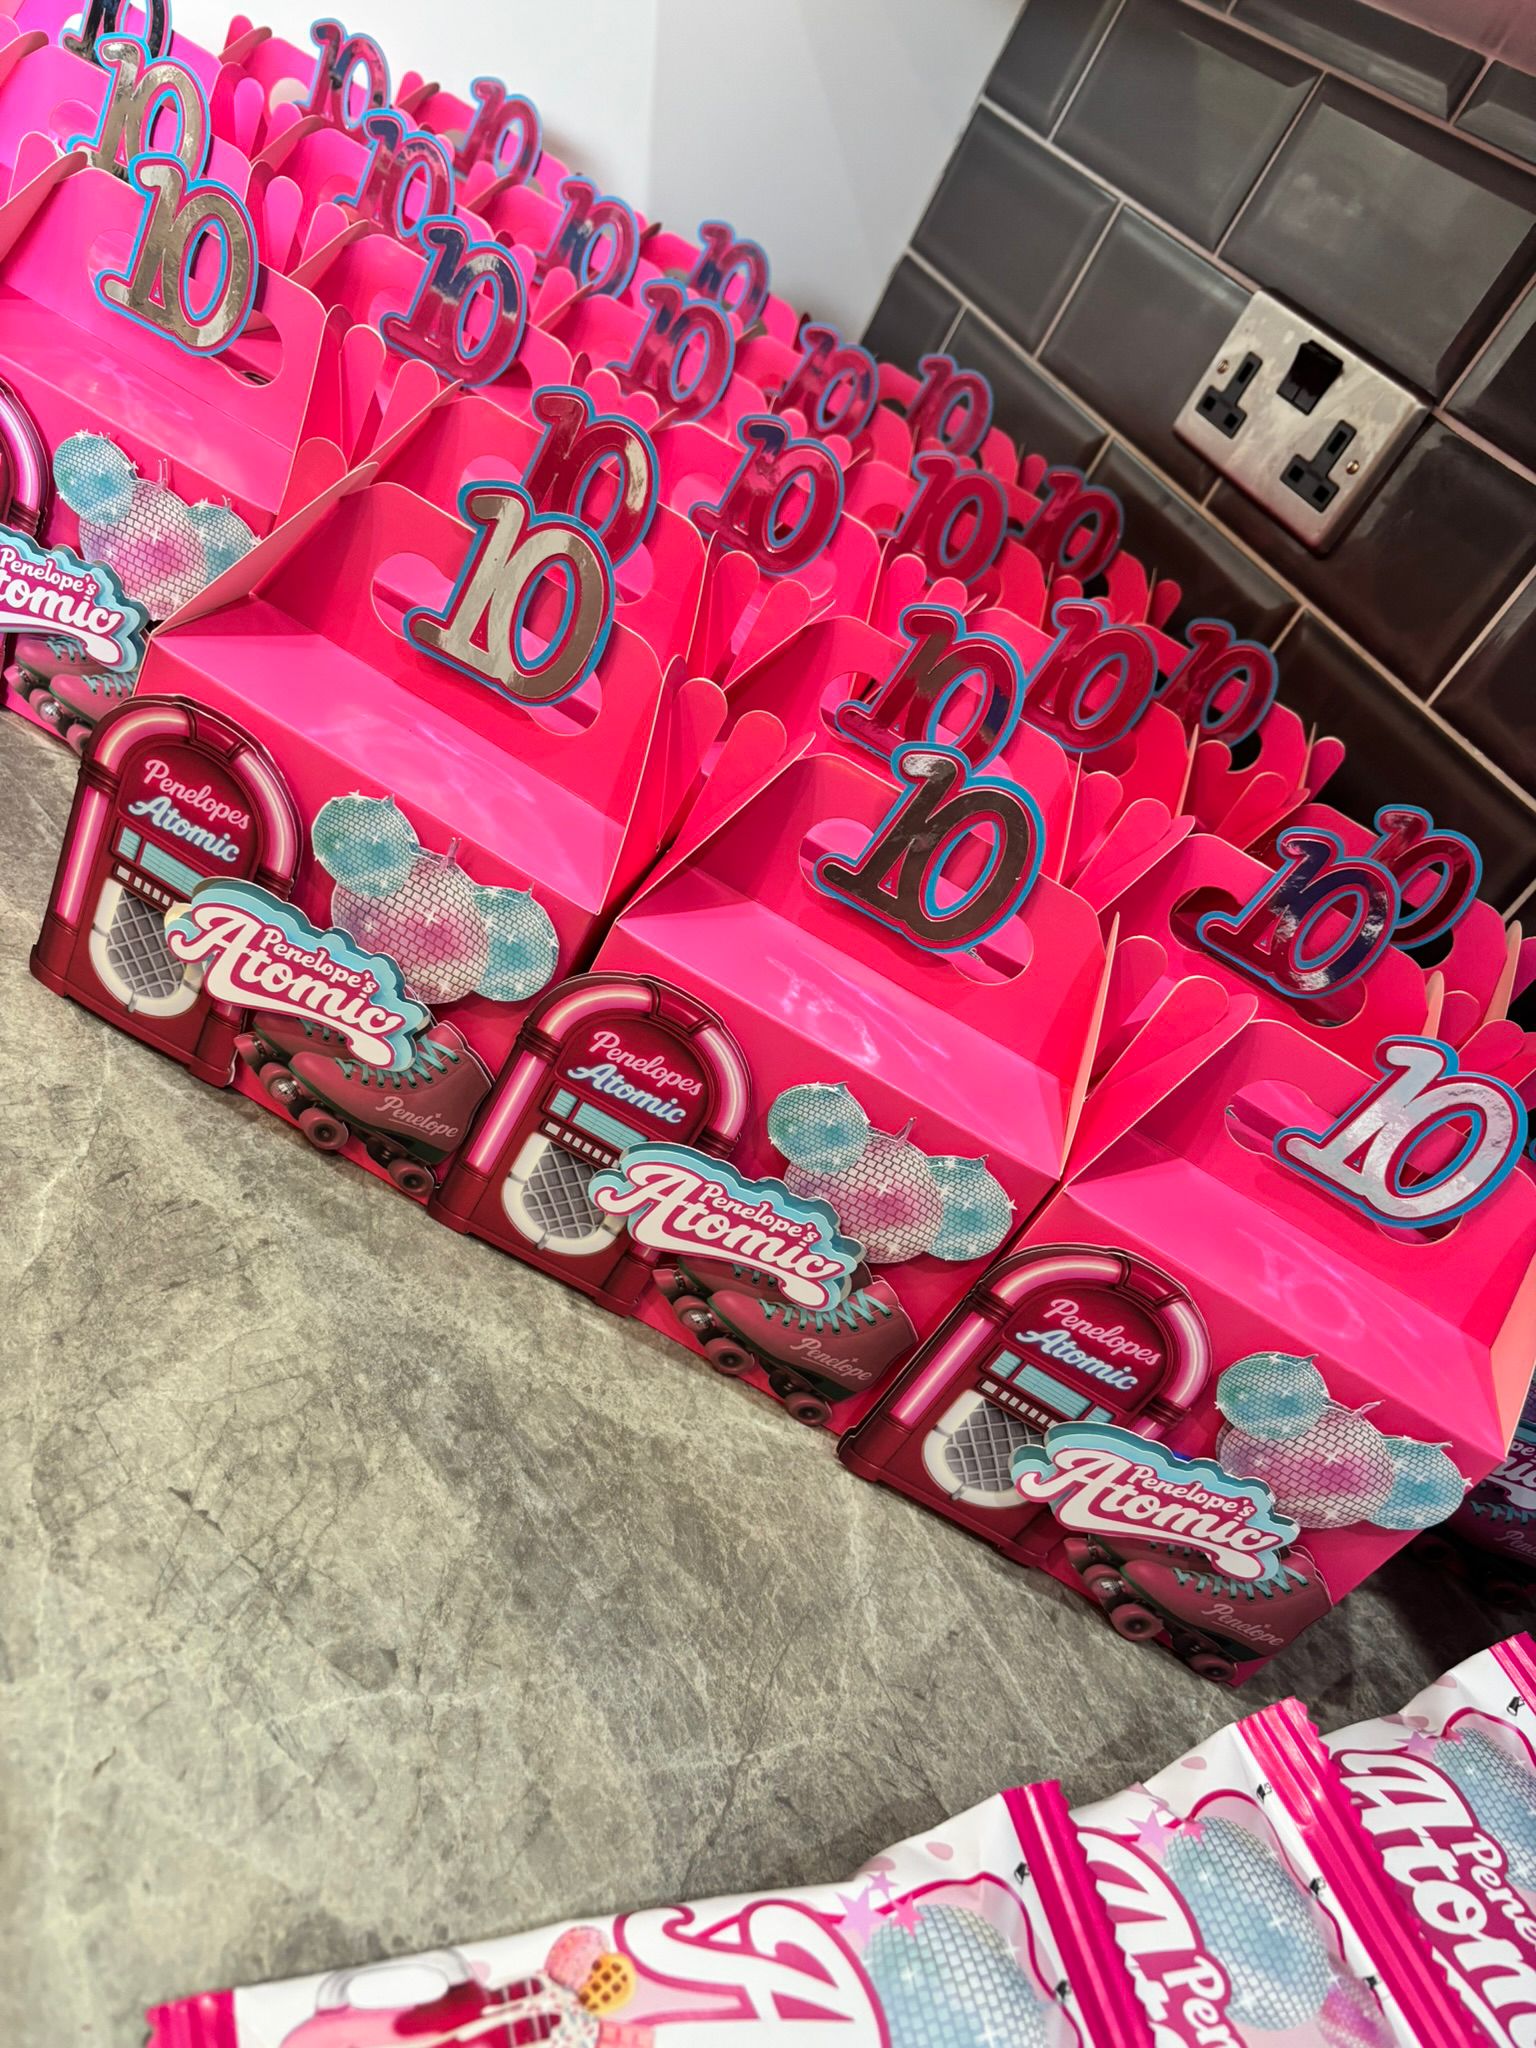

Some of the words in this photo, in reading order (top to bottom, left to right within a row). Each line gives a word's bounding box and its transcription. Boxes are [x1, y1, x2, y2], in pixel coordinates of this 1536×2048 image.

[337, 111, 454, 238] 10
[97, 154, 256, 355] 10
[382, 217, 526, 386] 10
[609, 280, 734, 421] 10
[691, 416, 842, 574] 10
[898, 453, 1006, 585] 10
[0, 547, 97, 596] Penelope's
[405, 482, 616, 704] 10
[836, 600, 1023, 767] 10
[1027, 600, 1156, 751] 10
[1158, 619, 1277, 746] 10
[128, 795, 240, 862] Atomic
[143, 759, 250, 829] Penelopes
[816, 744, 1043, 951] 10
[258, 928, 377, 994] Penelope's
[1199, 827, 1399, 997] 10
[169, 905, 402, 1067] Atomic
[375, 1095, 459, 1138] Penelope
[567, 1063, 686, 1123] Atomic
[588, 1031, 703, 1096] Penelopes
[1275, 1036, 1526, 1226] 10
[598, 1164, 842, 1307] Atomic
[700, 1184, 819, 1244] Penelope's
[790, 1337, 873, 1382] Penelope
[1015, 1329, 1138, 1390] Atomic
[1043, 1299, 1161, 1365] Penelopes
[1020, 1449, 1281, 1579] Atomic
[1127, 1465, 1255, 1517] Penelope's
[1201, 1603, 1286, 1647] Penelope
